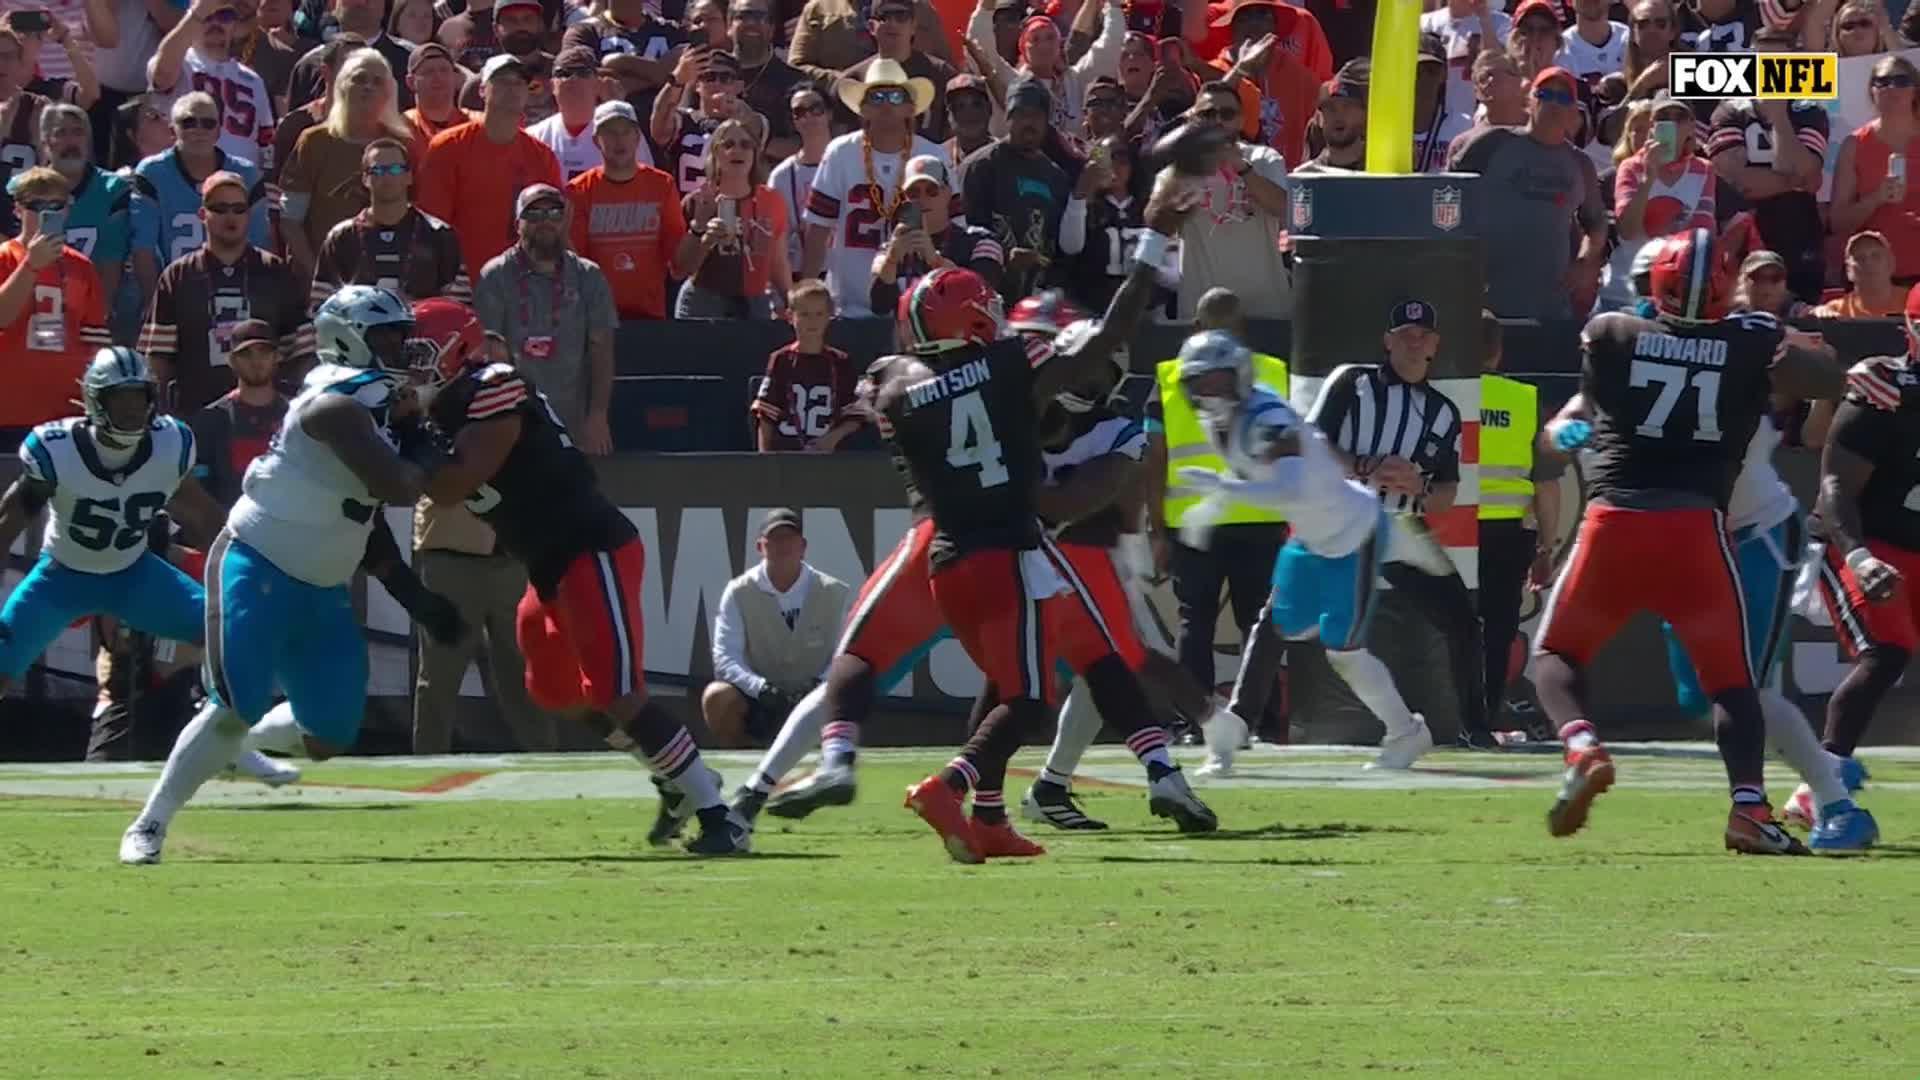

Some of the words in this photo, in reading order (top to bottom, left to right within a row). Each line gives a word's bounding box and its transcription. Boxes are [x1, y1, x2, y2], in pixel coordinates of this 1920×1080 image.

[1635, 332, 1728, 366] HOWARD
[905, 358, 991, 408] WATSON
[1629, 360, 1723, 442] 71
[945, 390, 1009, 488] 4
[69, 491, 167, 551] 58
